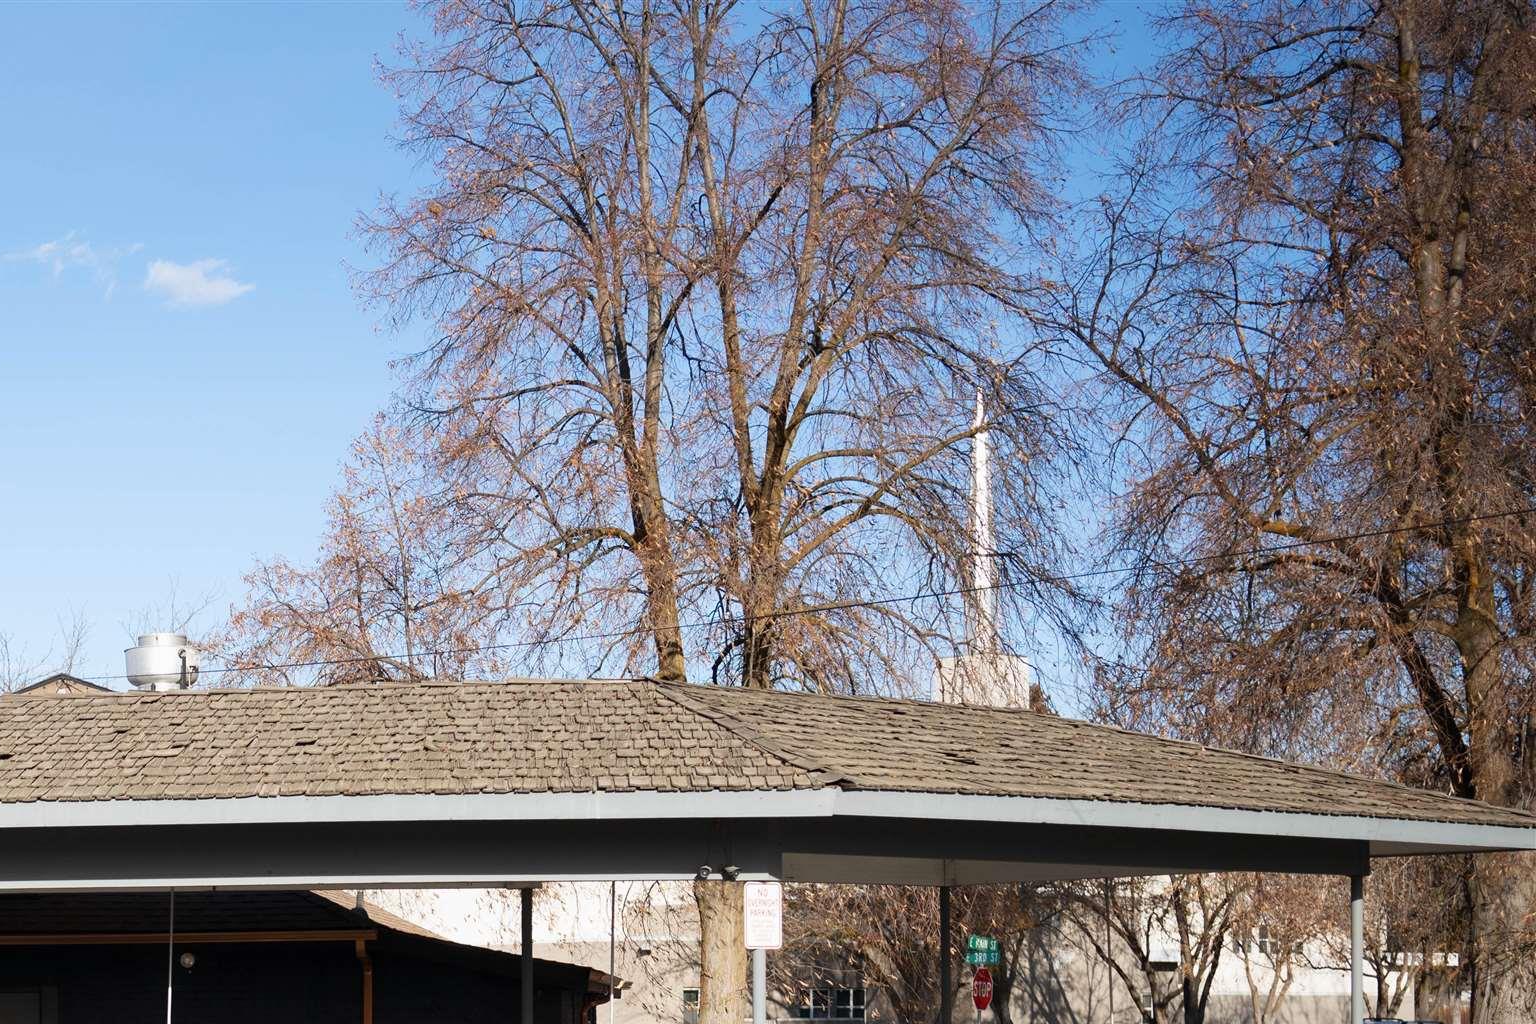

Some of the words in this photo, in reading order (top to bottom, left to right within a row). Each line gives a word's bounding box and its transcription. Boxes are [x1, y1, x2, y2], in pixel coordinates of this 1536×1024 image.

[757, 888, 768, 897] NO
[990, 940, 997, 950] ST
[974, 953, 987, 962] 3RD
[990, 953, 998, 962] ST
[974, 981, 991, 997] STOP
